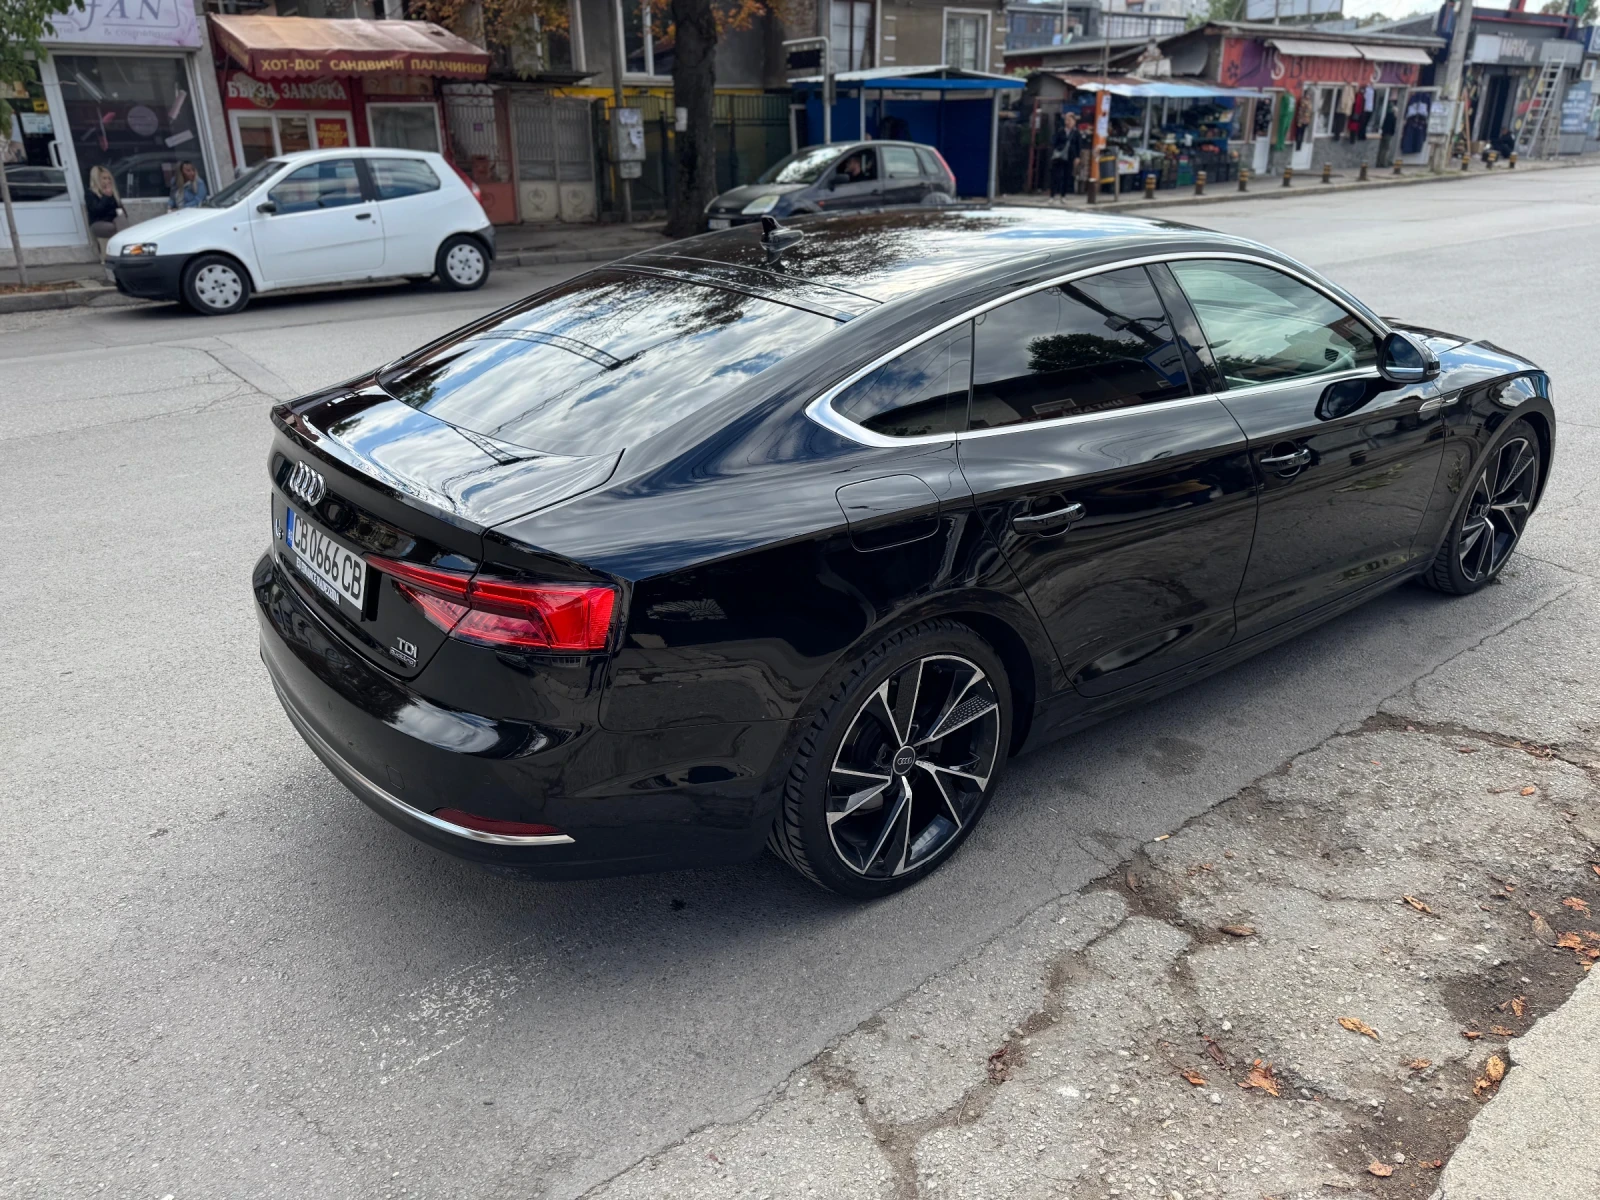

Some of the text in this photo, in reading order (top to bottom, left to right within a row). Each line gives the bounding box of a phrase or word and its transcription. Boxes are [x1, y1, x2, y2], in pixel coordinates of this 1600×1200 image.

[261, 59, 487, 73] ХОТ-ДОГ САНДВИЧИ ПАЛАЧИНКИ
[227, 81, 347, 100] БЪРЗА ЗАКУСКА
[294, 514, 309, 555] CB
[309, 528, 340, 582] 0666
[341, 554, 362, 600] CB
[396, 636, 417, 659] TDI
